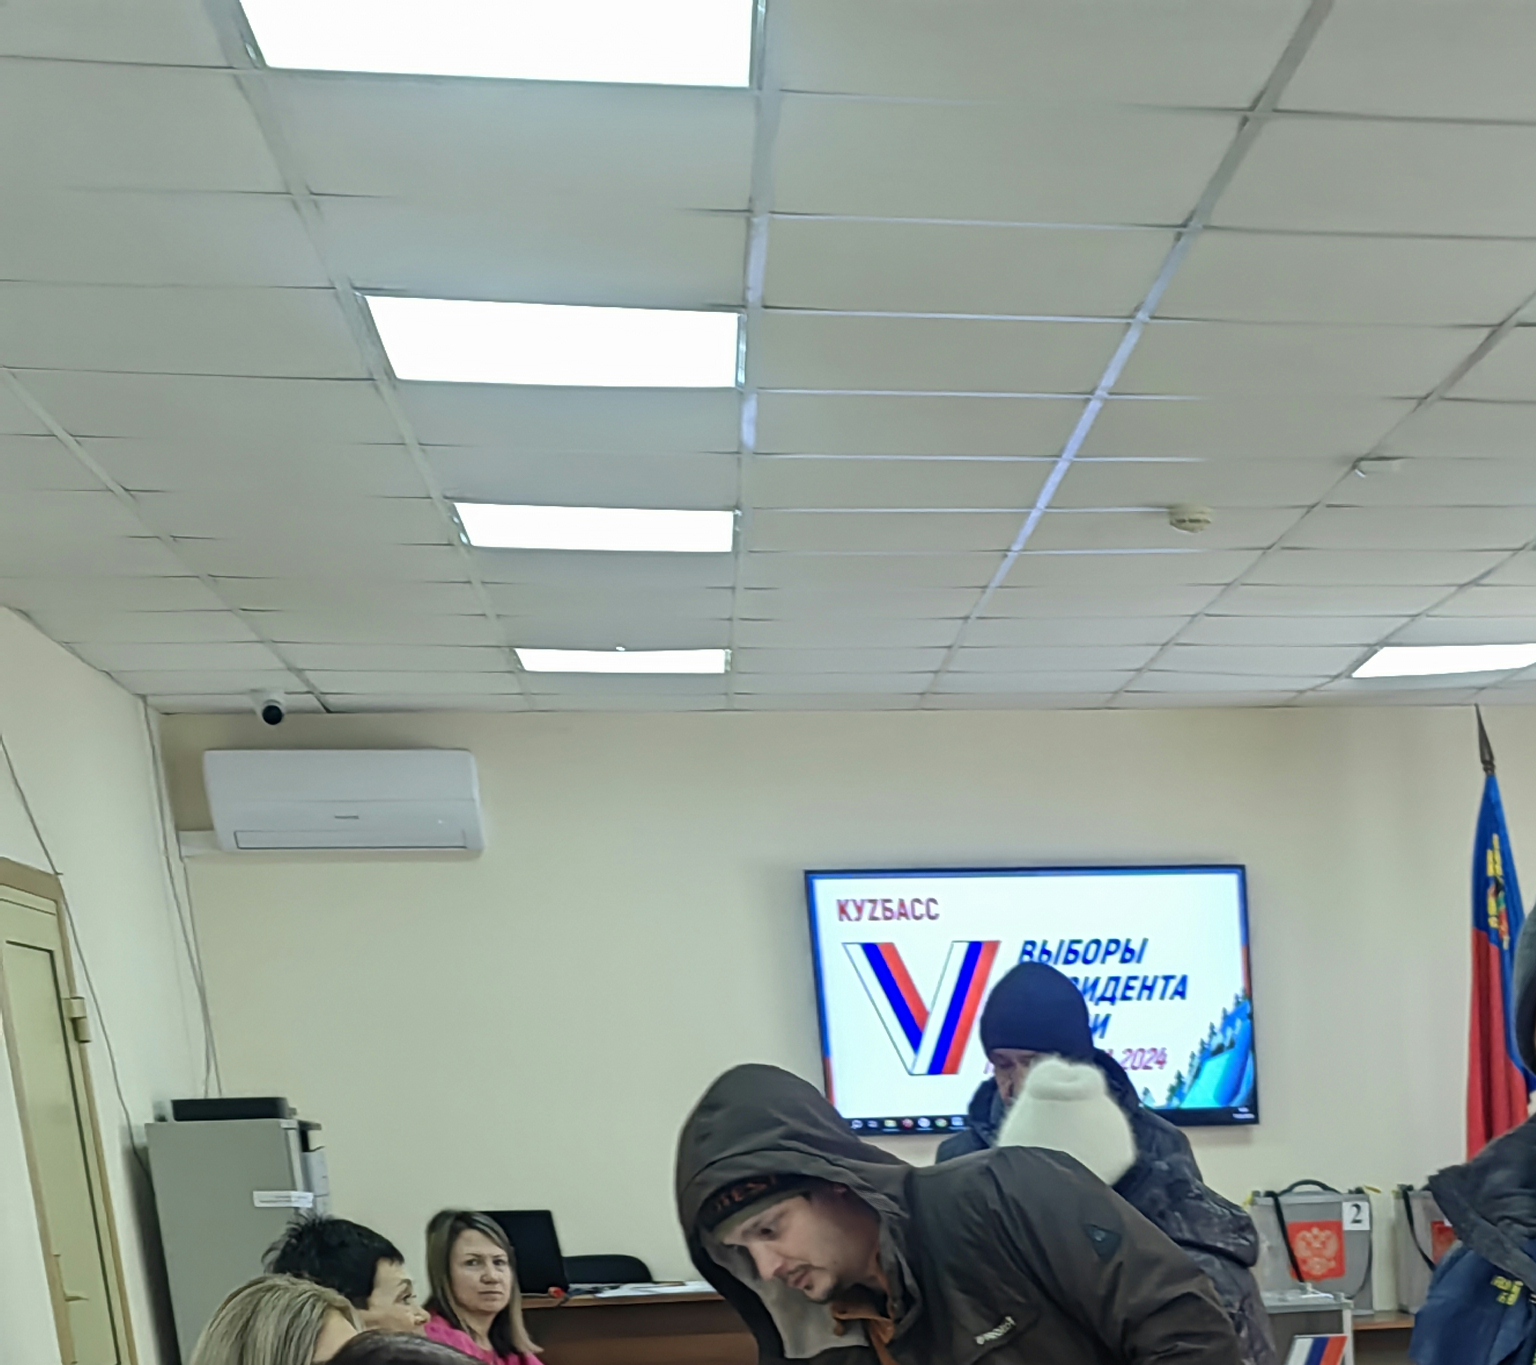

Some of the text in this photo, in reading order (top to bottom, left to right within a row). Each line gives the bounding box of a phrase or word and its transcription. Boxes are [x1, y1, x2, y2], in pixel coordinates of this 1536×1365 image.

[1018, 937, 1149, 965] ВЫБОРЫ
[1069, 974, 1188, 1006] ИДЕНТА
[1120, 1047, 1167, 1071] 2024
[1350, 1203, 1363, 1224] 2
